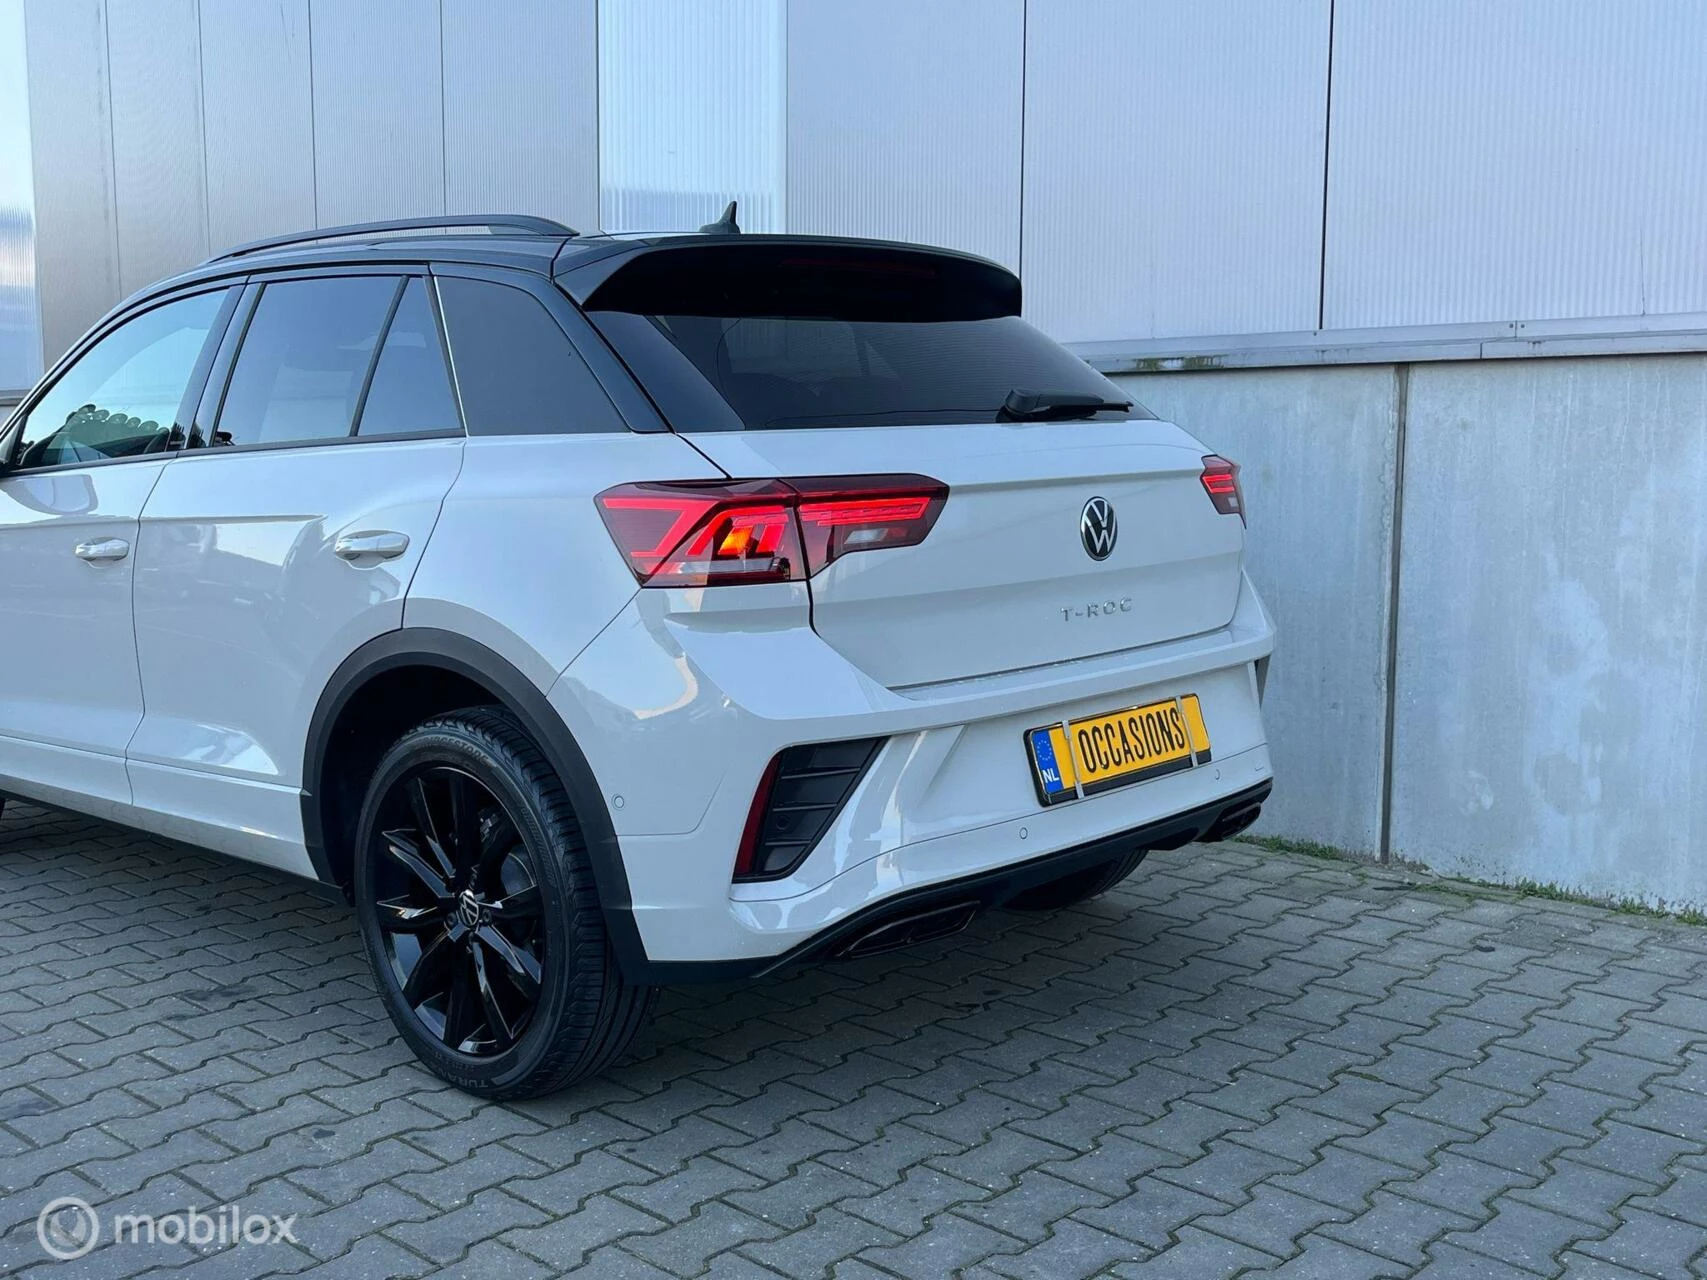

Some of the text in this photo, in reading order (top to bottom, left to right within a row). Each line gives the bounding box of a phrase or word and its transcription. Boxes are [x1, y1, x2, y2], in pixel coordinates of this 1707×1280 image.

[1060, 597, 1132, 621] T-ROC
[1078, 707, 1185, 773] OCCASIONS
[1042, 769, 1060, 784] NL
